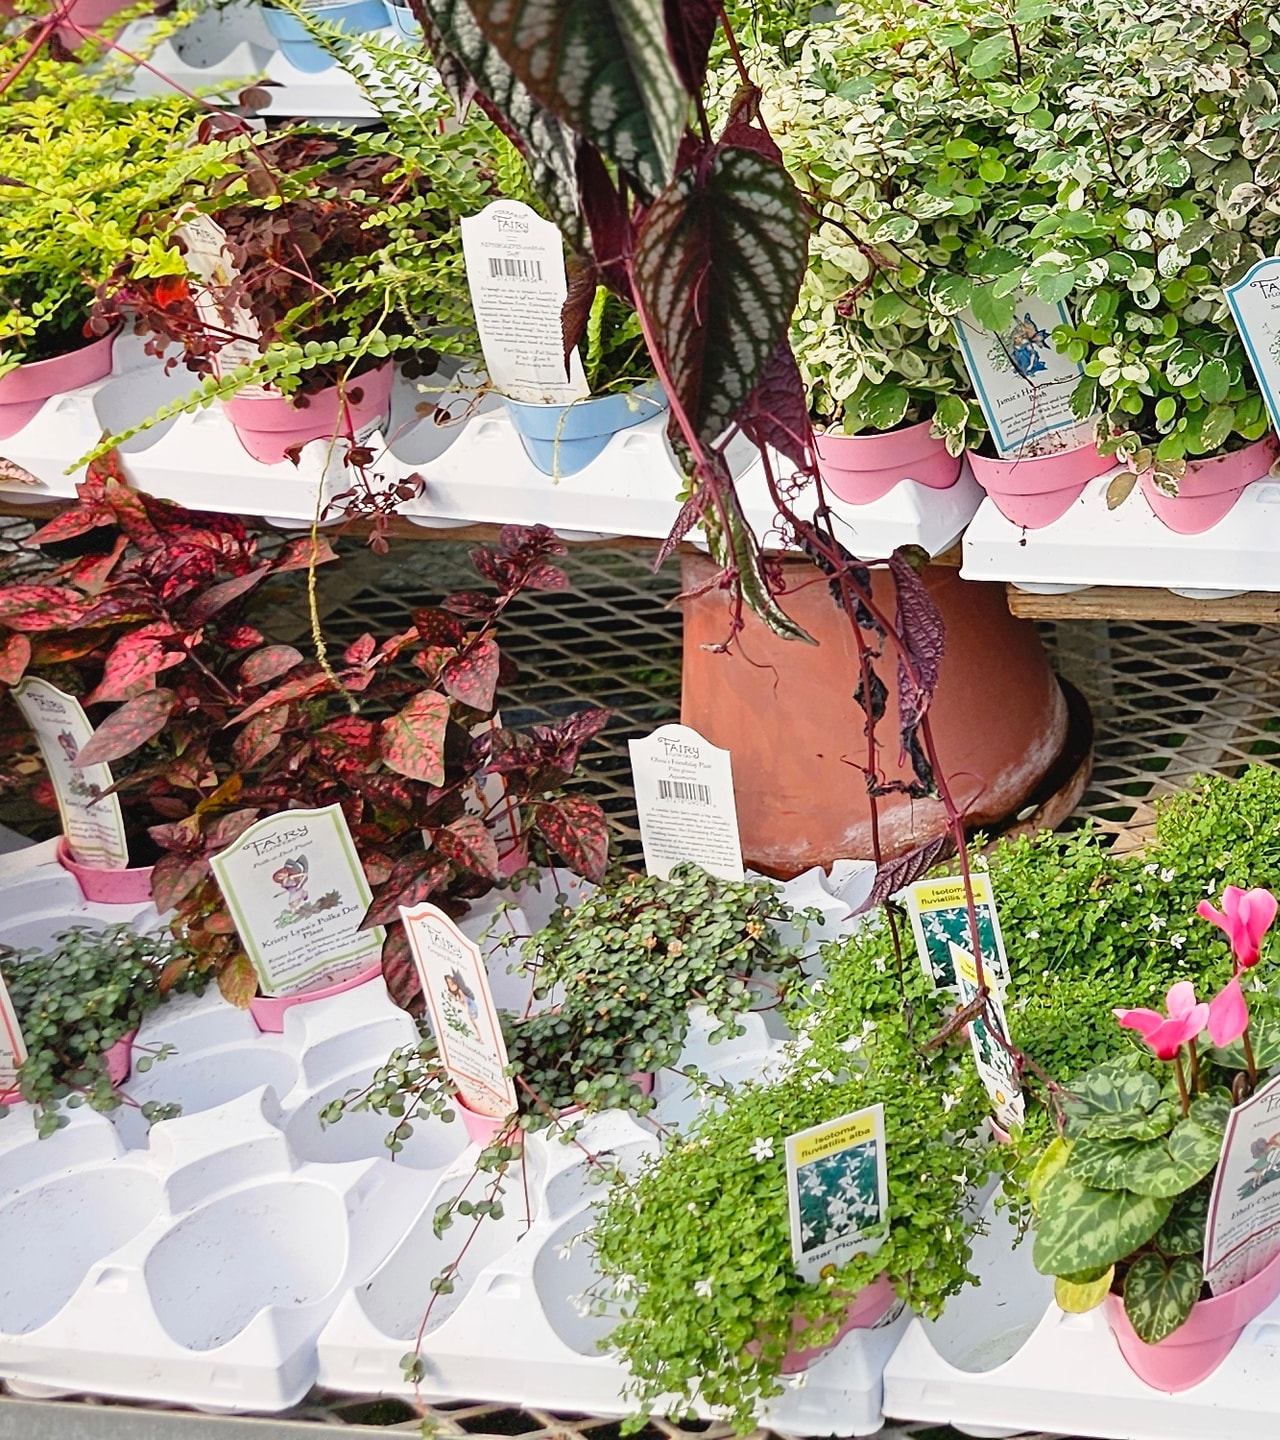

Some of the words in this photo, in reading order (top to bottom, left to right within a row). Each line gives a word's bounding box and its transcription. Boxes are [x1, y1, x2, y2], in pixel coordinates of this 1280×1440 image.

[657, 736, 699, 759] FAIRY
[242, 825, 309, 857] FAIRY
[261, 934, 289, 949] Kristy
[290, 922, 316, 937] Lynn's
[317, 913, 341, 927] Polka
[342, 904, 360, 915] Dot
[302, 928, 324, 940] Plant
[802, 1138, 846, 1158] fluviatilis
[849, 1129, 871, 1140] alba
[815, 1125, 856, 1145] Isotoma
[808, 1246, 832, 1264] Star
